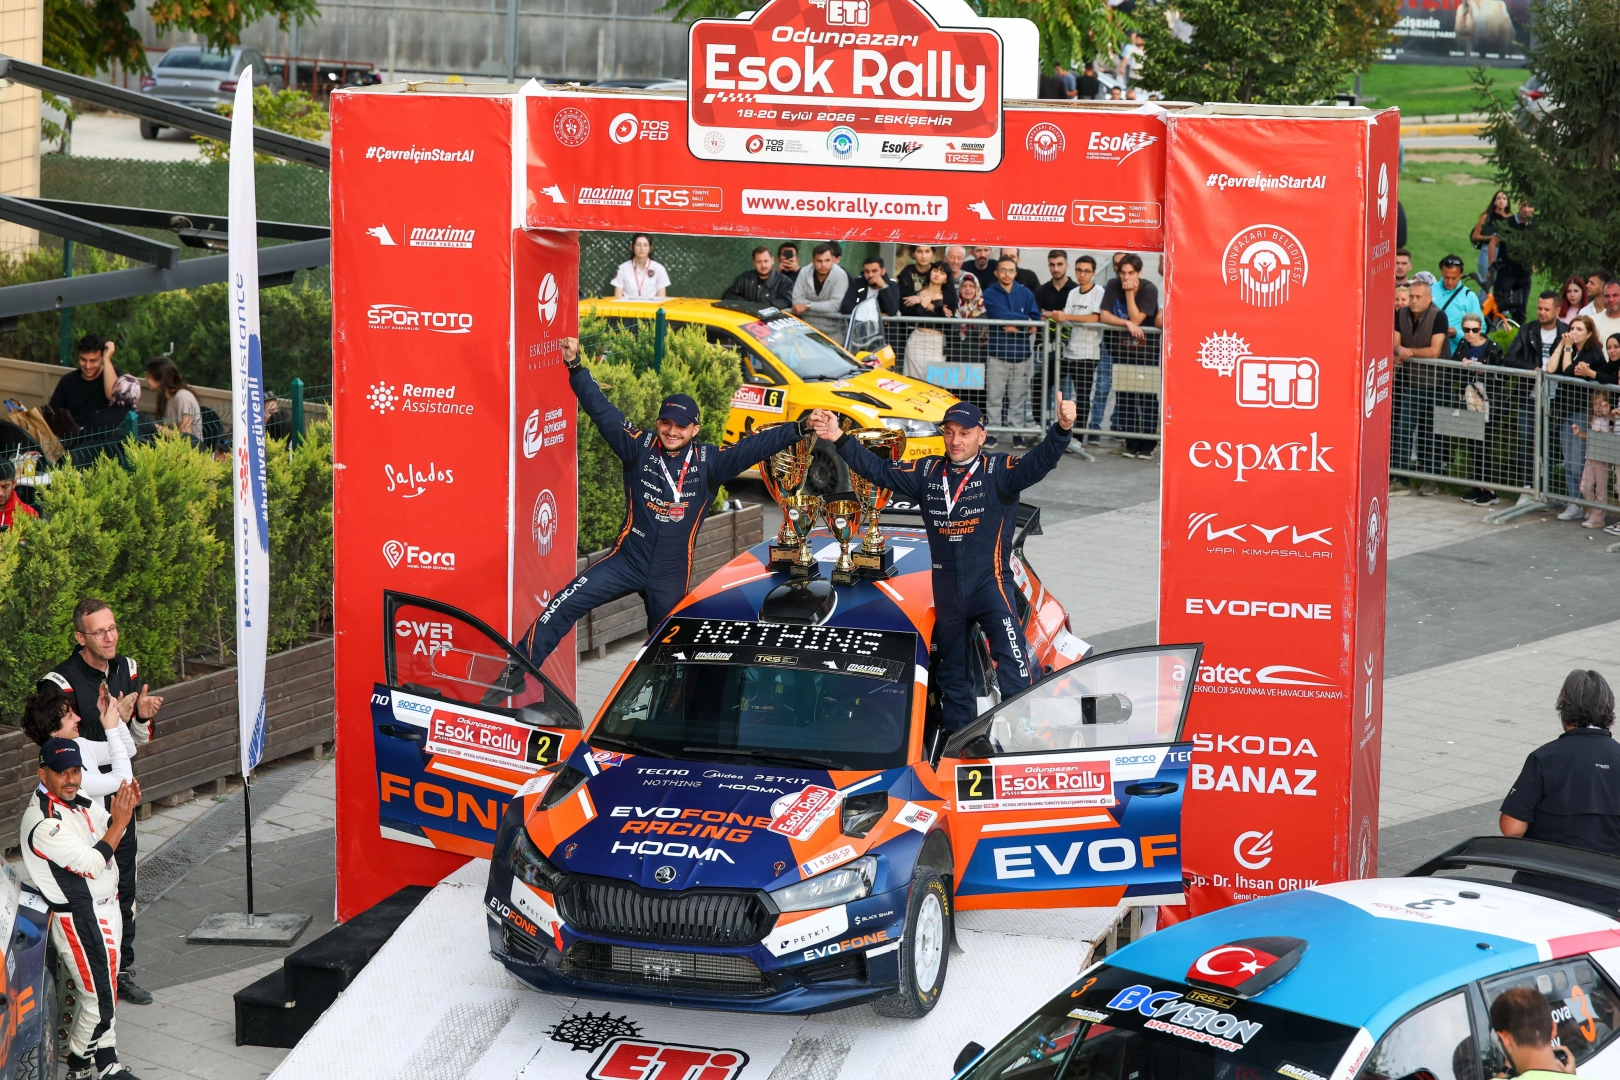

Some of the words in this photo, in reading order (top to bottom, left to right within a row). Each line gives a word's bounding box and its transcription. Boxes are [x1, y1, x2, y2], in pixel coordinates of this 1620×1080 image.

[771, 26, 918, 47] Odunpazarı
[706, 44, 834, 94] Esok
[853, 49, 986, 106] Rally
[640, 120, 670, 131] TOS
[736, 108, 777, 119] 18-20
[781, 110, 812, 122] Eylül
[816, 112, 856, 122] 2026
[874, 114, 953, 127] ESKİŞEHİR
[639, 131, 669, 141] FED
[1087, 131, 1131, 152] Esok
[881, 140, 908, 154] Esok
[946, 153, 970, 163] TRS
[578, 185, 635, 201] maxima
[641, 189, 690, 207] TRS
[747, 195, 943, 217] www.esokrally.com.tr
[1008, 201, 1068, 216] maxima
[1075, 205, 1127, 223] TRS
[410, 225, 475, 242] maxima
[1229, 230, 1266, 282] ODUNPAZARI
[1271, 231, 1302, 284] BELEDİYESİ
[236, 272, 248, 426] Assistance
[926, 364, 983, 388] POLİS
[403, 384, 455, 399] Remed
[769, 392, 778, 406] 6
[402, 399, 474, 415] Assistance
[1188, 431, 1335, 482] espark
[384, 462, 454, 491] Salados
[643, 492, 690, 508] EVOFE
[646, 501, 670, 516] RACI
[933, 518, 980, 528] EVOFONE
[1206, 522, 1333, 546] KYK
[407, 546, 455, 566] Fora
[1206, 547, 1235, 555] YAPI
[540, 576, 588, 624] EVOFONE
[1186, 598, 1332, 620] EVOFONE
[395, 620, 453, 640] OWER
[661, 625, 681, 644] 2
[693, 620, 883, 655] NOTHING
[413, 640, 453, 657] APP
[694, 651, 734, 660] maxima
[1002, 617, 1029, 678] EVOFONE
[847, 663, 888, 675] maxima
[1172, 660, 1252, 685] afatec
[1193, 684, 1228, 694] EKNOLOJİ
[1229, 686, 1265, 695] SAVUNMA
[1266, 688, 1276, 696] VE
[1277, 689, 1314, 699] HAVACILIK
[1315, 690, 1343, 700] SANAYİ
[396, 699, 432, 713] sparco
[457, 716, 503, 731] Odunpazarı
[435, 719, 475, 743] Esok
[480, 728, 522, 754] Rally
[536, 736, 551, 763] 2
[1025, 765, 1079, 774] Odunpazarı
[1115, 754, 1157, 766] sparco
[636, 767, 690, 776] TECNO
[710, 771, 744, 780] Midea
[643, 779, 703, 788] NOTHING
[968, 769, 983, 797] 2
[1001, 772, 1050, 791] Esok
[1055, 772, 1105, 791] Rally
[1192, 763, 1317, 796] BANAZ
[380, 771, 507, 832] FON
[777, 809, 808, 832] Esok
[797, 788, 829, 810] Rally
[610, 806, 773, 829] EVOFONE
[619, 820, 754, 843] RACING
[993, 833, 1178, 880] EVOF
[1213, 873, 1232, 888] Dr.
[1235, 873, 1274, 890] İhsan
[489, 896, 538, 938] EVOFONE
[793, 925, 831, 945] PETKIT
[803, 930, 889, 962] EVOFONE
[1071, 977, 1098, 998] 3
[1571, 985, 1597, 1043] 3
[1144, 1018, 1244, 1053] MOTORSPORT
[1348, 1046, 1370, 1076] Mamma
